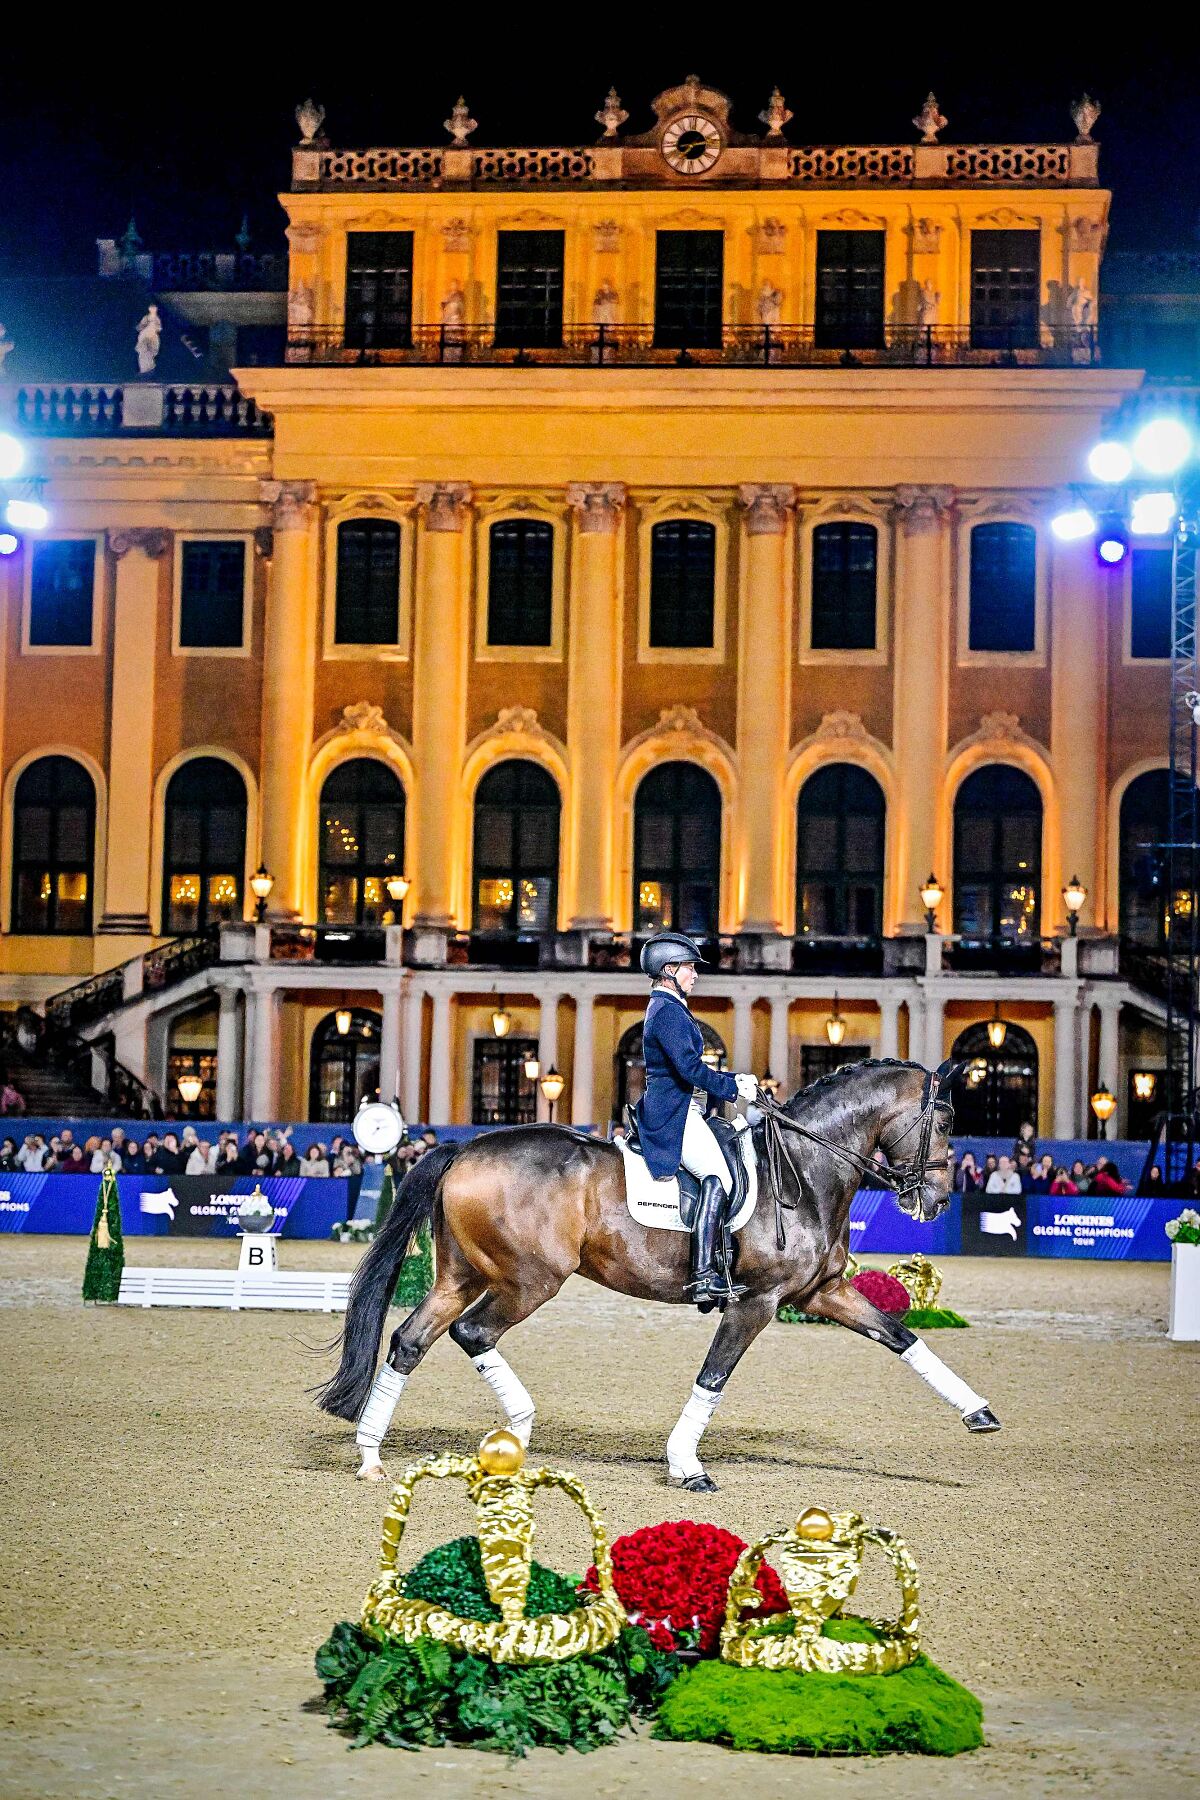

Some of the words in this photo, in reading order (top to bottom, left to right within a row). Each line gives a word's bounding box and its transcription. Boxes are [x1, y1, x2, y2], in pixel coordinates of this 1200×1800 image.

[637, 1201, 678, 1209] DEFENDER
[190, 1206, 228, 1216] GLOBAL
[1054, 1215, 1114, 1226] LONGINES
[1033, 1226, 1072, 1236] GLOBAL
[1074, 1227, 1134, 1238] CHAMPIONS
[1073, 1238, 1095, 1246] TOUR
[249, 1247, 263, 1265] B
